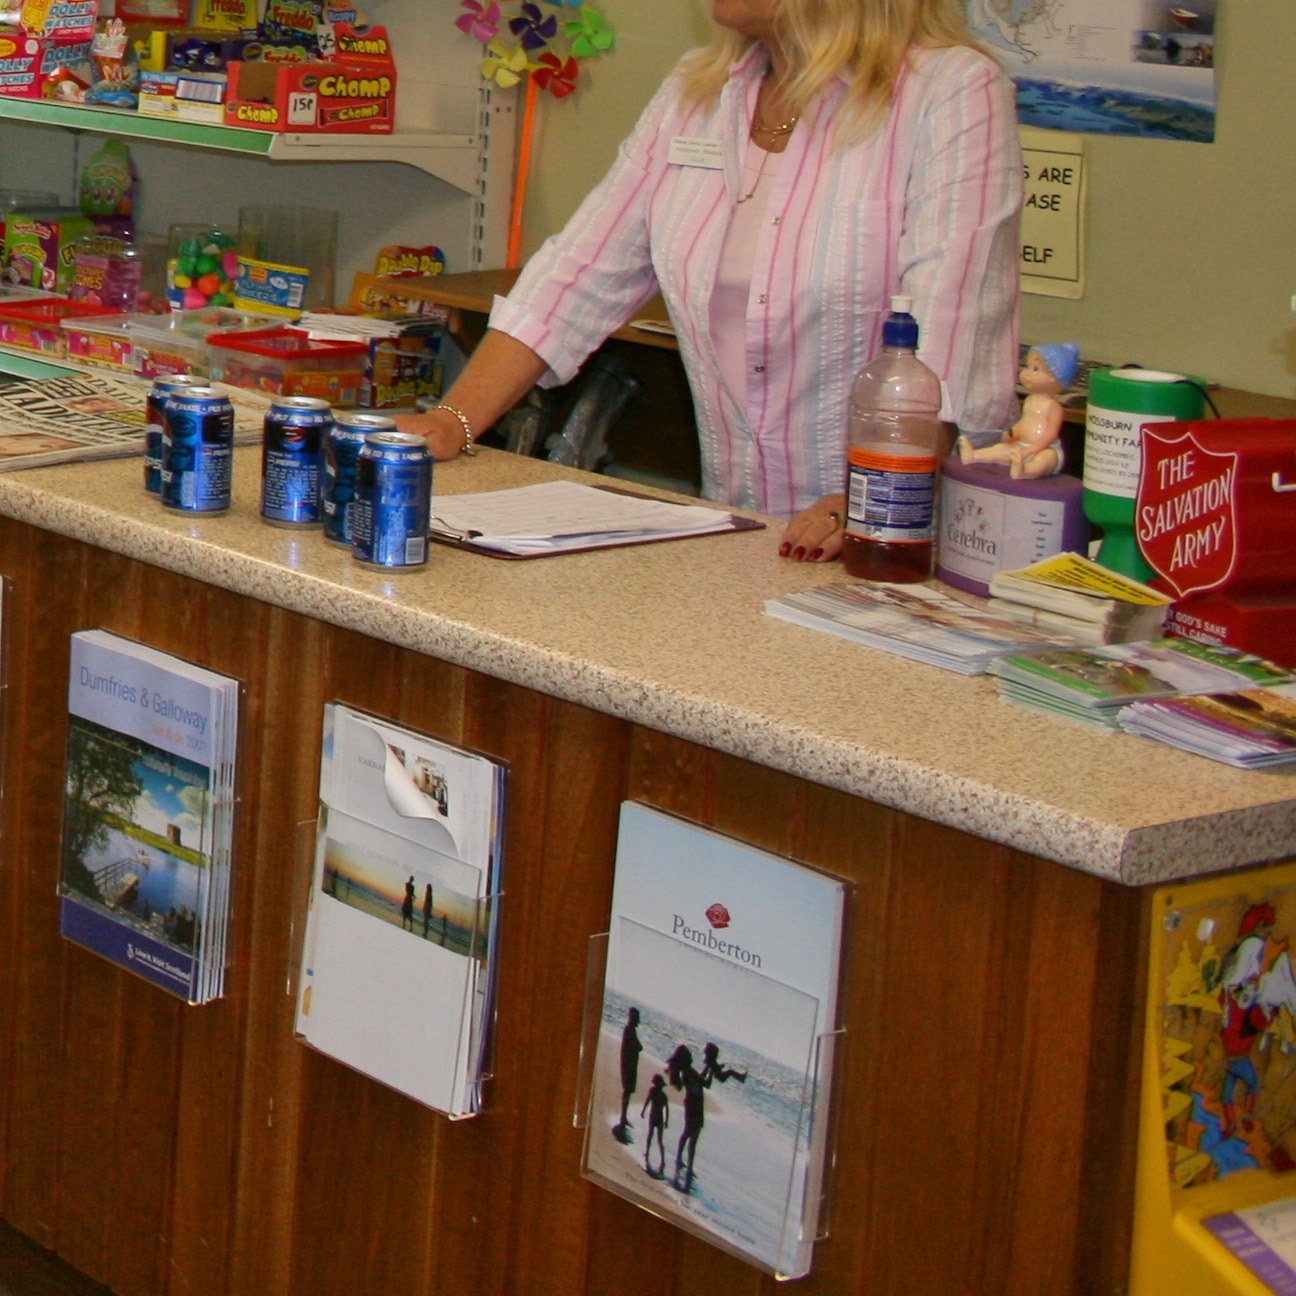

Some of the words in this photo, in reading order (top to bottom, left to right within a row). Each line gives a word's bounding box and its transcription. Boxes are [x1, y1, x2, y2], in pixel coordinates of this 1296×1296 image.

[49, 0, 96, 16] DOLLY
[1038, 167, 1073, 185] ARE
[1025, 193, 1062, 212] ASE
[1022, 245, 1054, 264] ELF
[1158, 450, 1196, 491] THE
[1140, 468, 1232, 542] SALVATION
[947, 522, 997, 556] Cerebra
[1169, 515, 1226, 573] ARMY
[1175, 611, 1203, 629] GOD'S
[1204, 621, 1227, 638] SAKE
[80, 666, 137, 703] Dumfries
[152, 692, 207, 735] Galloway
[672, 913, 763, 968] Pemberton
